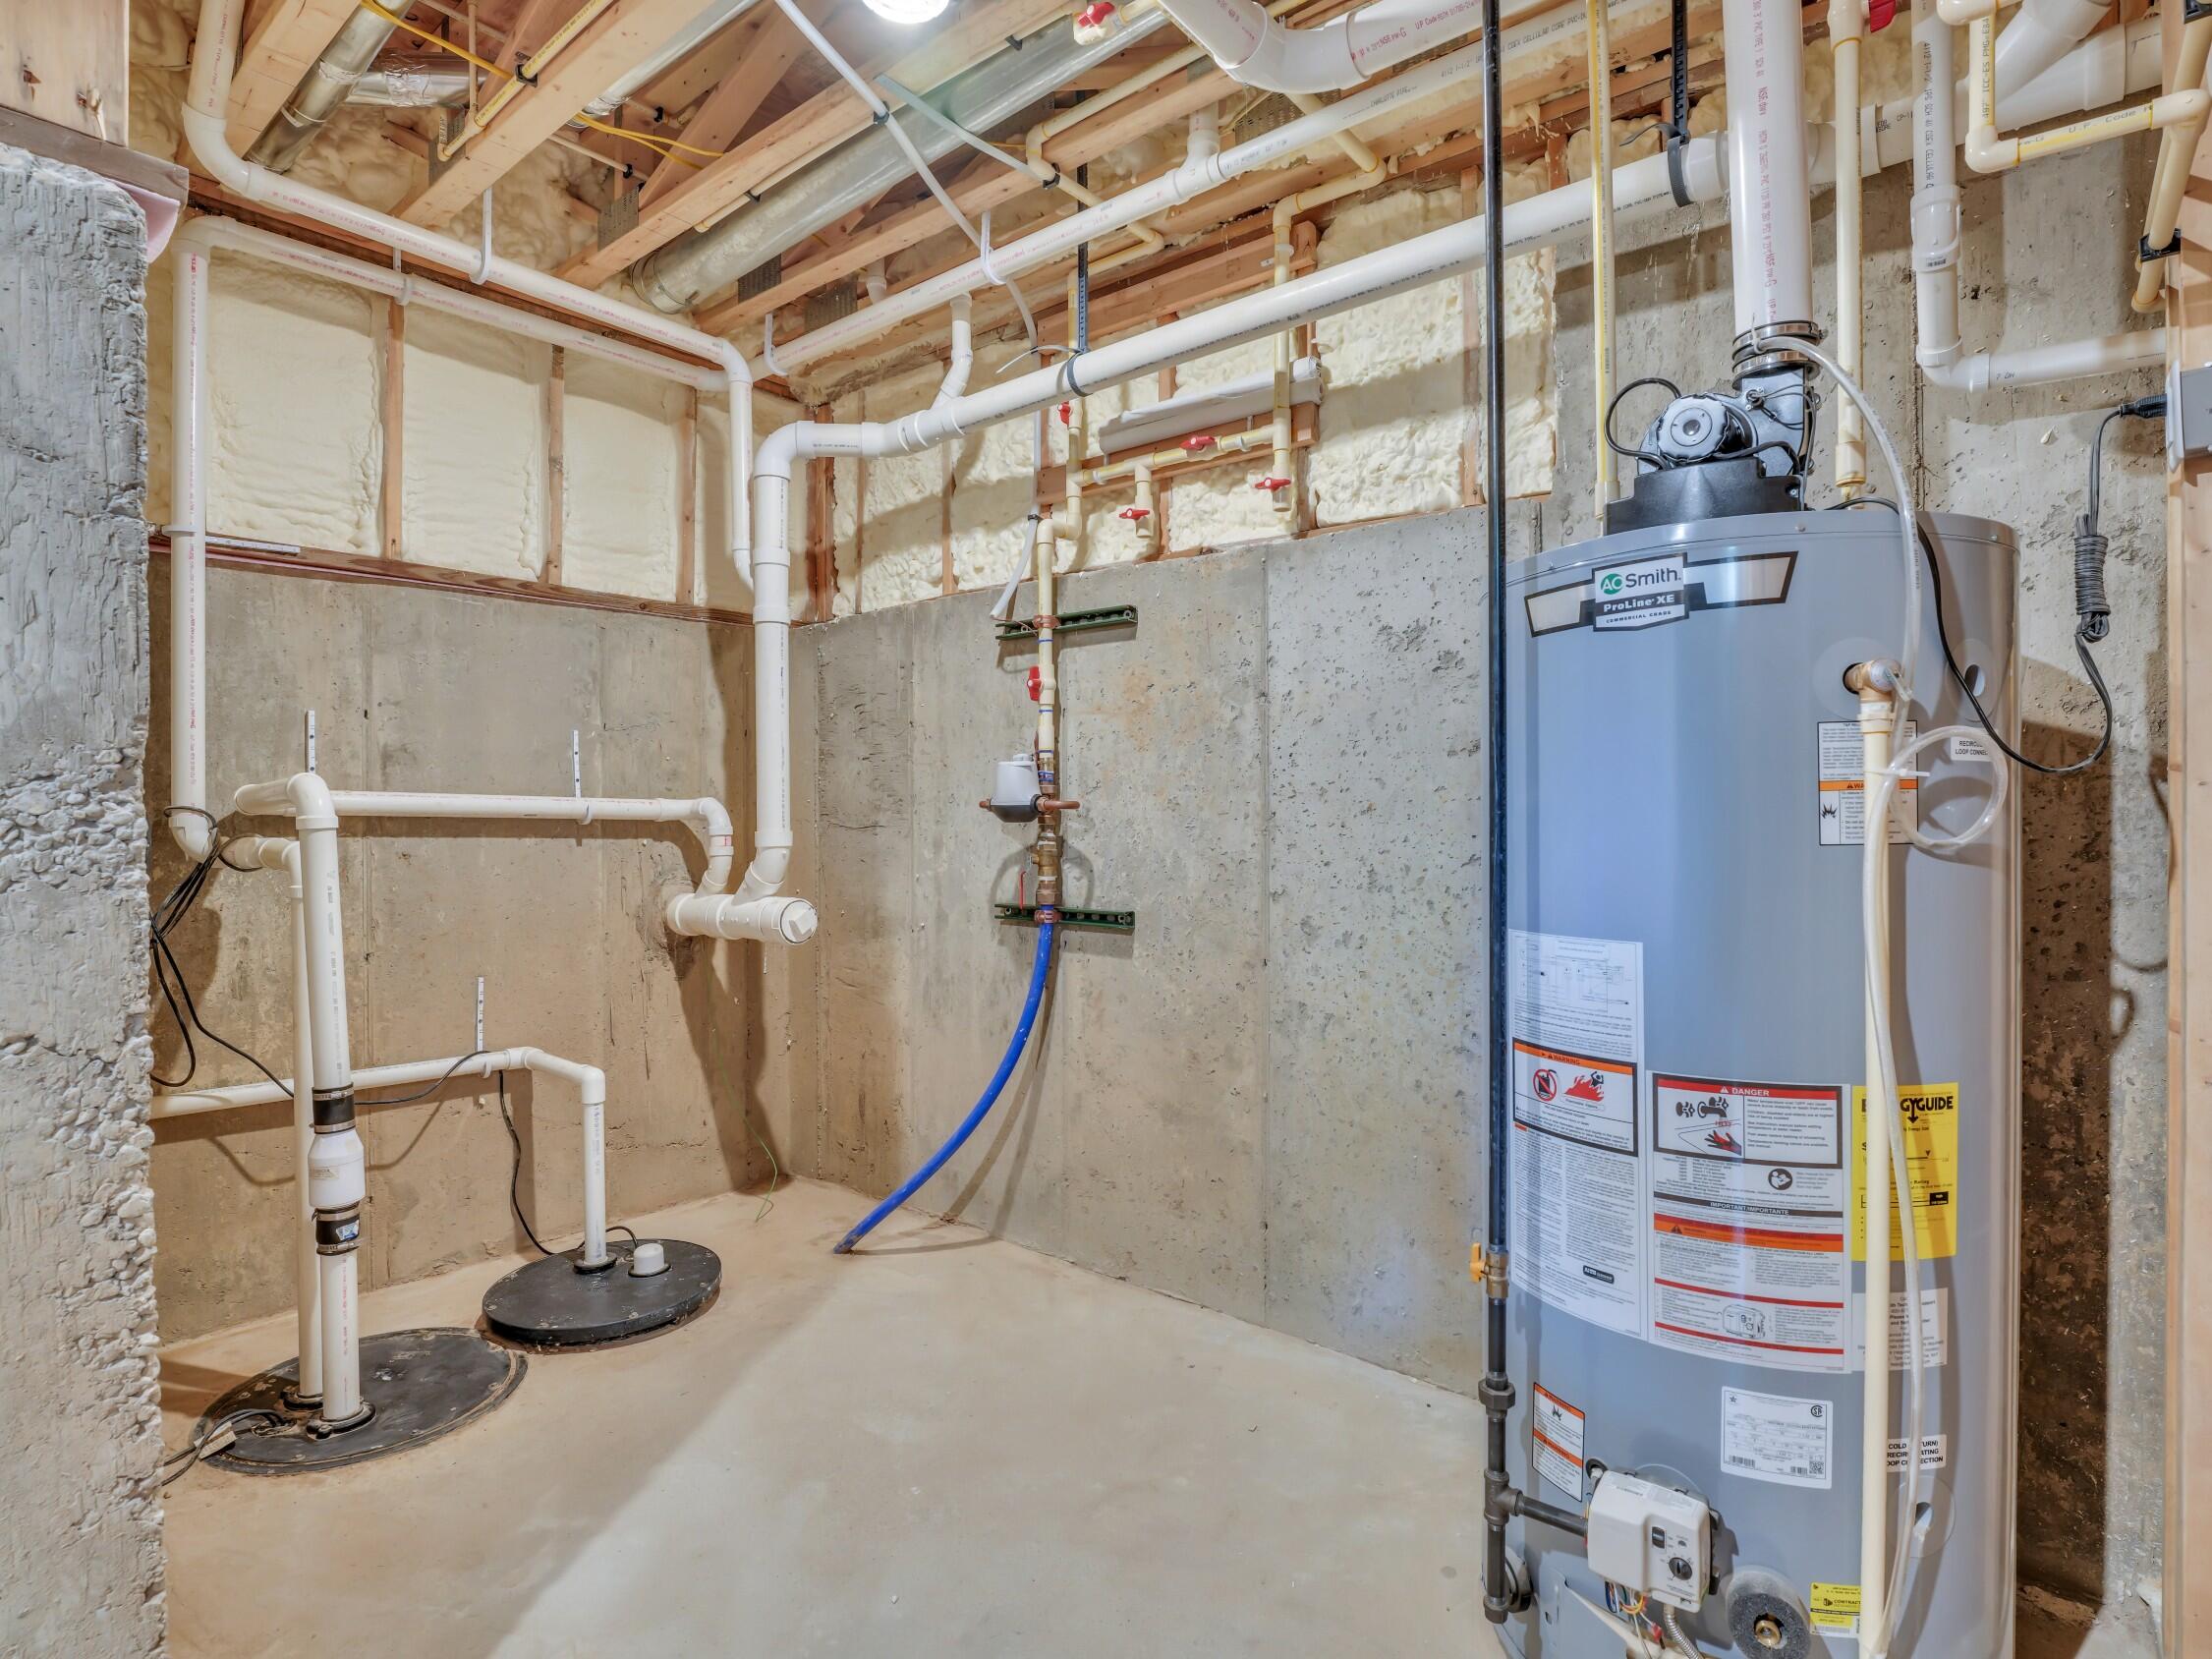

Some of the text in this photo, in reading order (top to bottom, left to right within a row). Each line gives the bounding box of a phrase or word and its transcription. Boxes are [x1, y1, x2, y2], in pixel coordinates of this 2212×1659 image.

[1625, 568, 1678, 588] Smith
[1603, 594, 1674, 613] ProLine XE
[1606, 612, 1647, 624] COMMERCIAL
[1554, 1054, 1580, 1065] WARNING
[1731, 1087, 1770, 1097] DANGER
